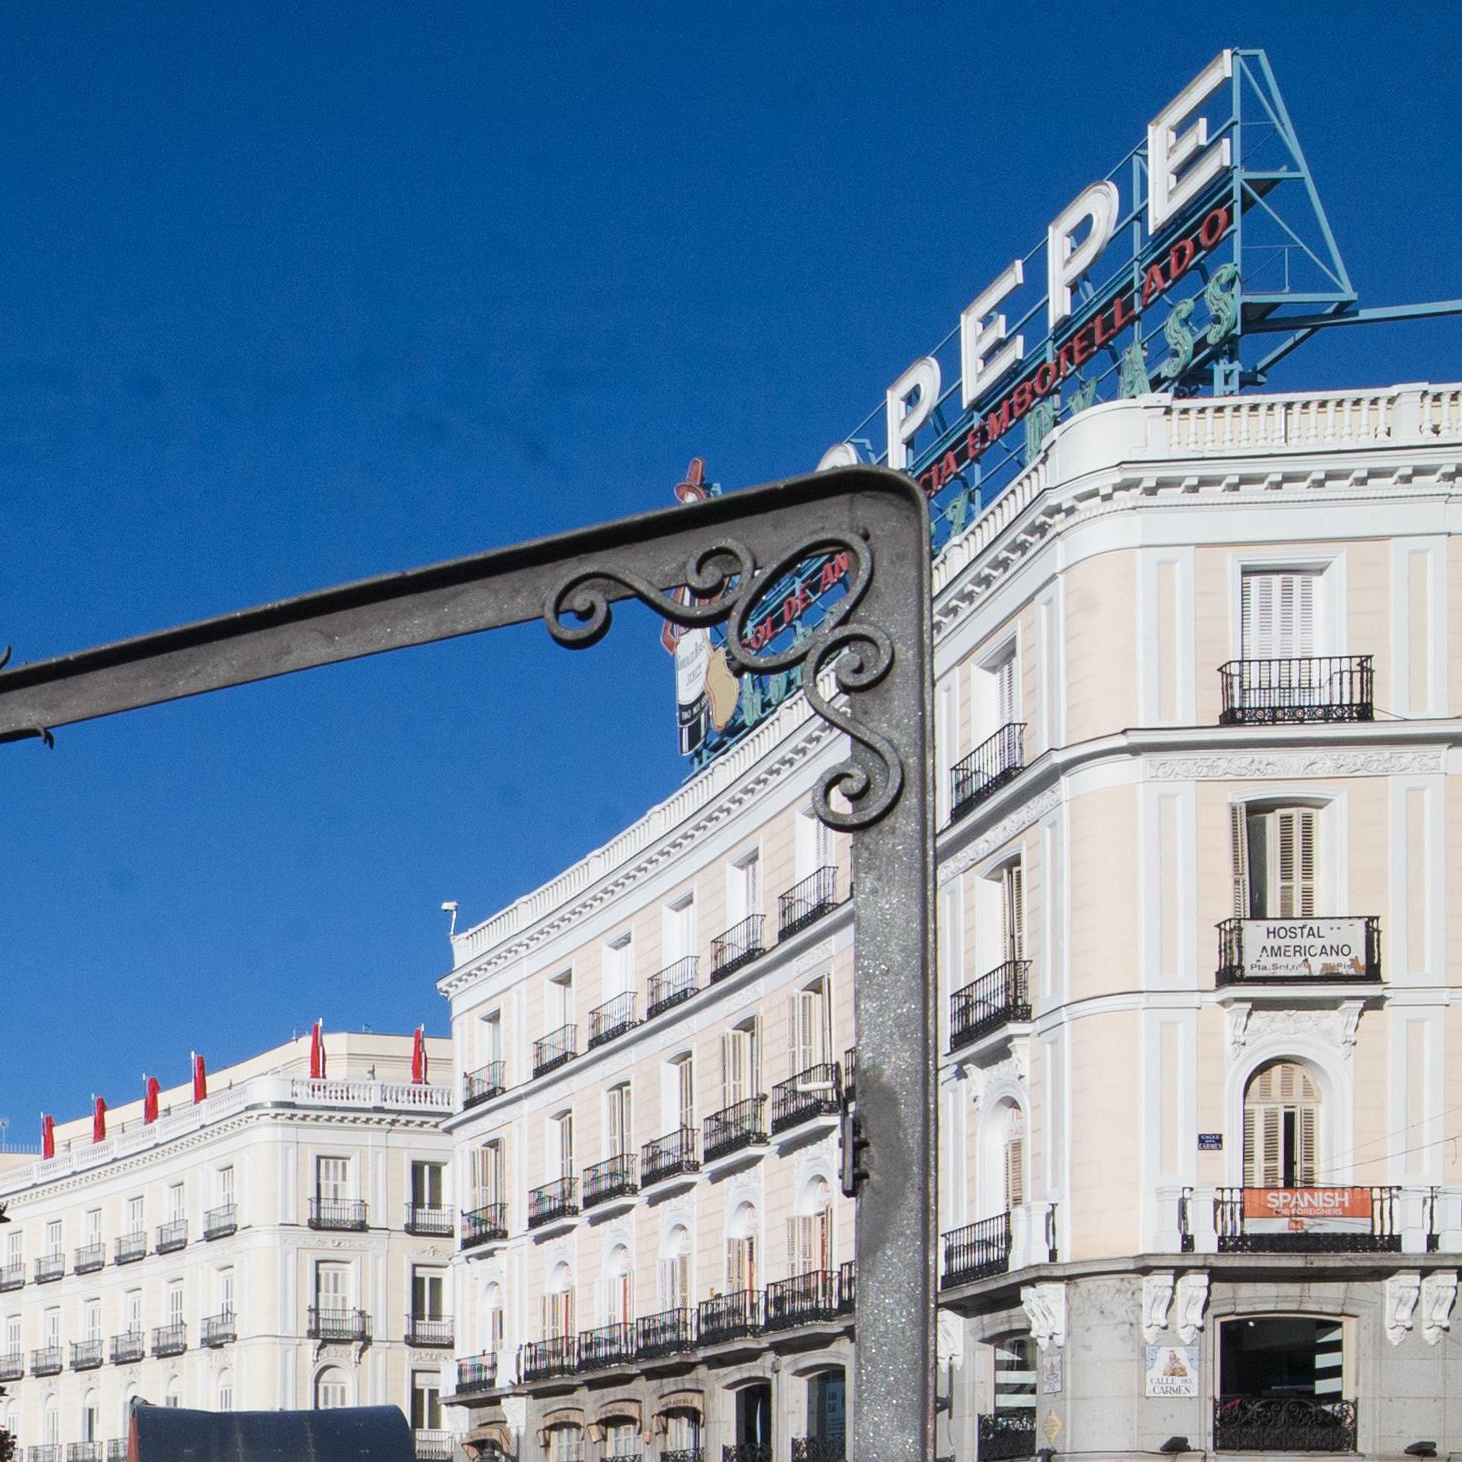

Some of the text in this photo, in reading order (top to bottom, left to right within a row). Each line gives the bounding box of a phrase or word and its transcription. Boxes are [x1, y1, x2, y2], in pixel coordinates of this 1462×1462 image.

[887, 48, 1232, 468] PEPE
[966, 207, 1230, 455] EMBOTELLADO
[1267, 926, 1325, 939] HOSTAL
[1259, 944, 1352, 958] AMERICANO
[1267, 1191, 1349, 1208] SPANISH
[1150, 1377, 1176, 1386] CALLE
[1152, 1386, 1193, 1395] CARMEN
